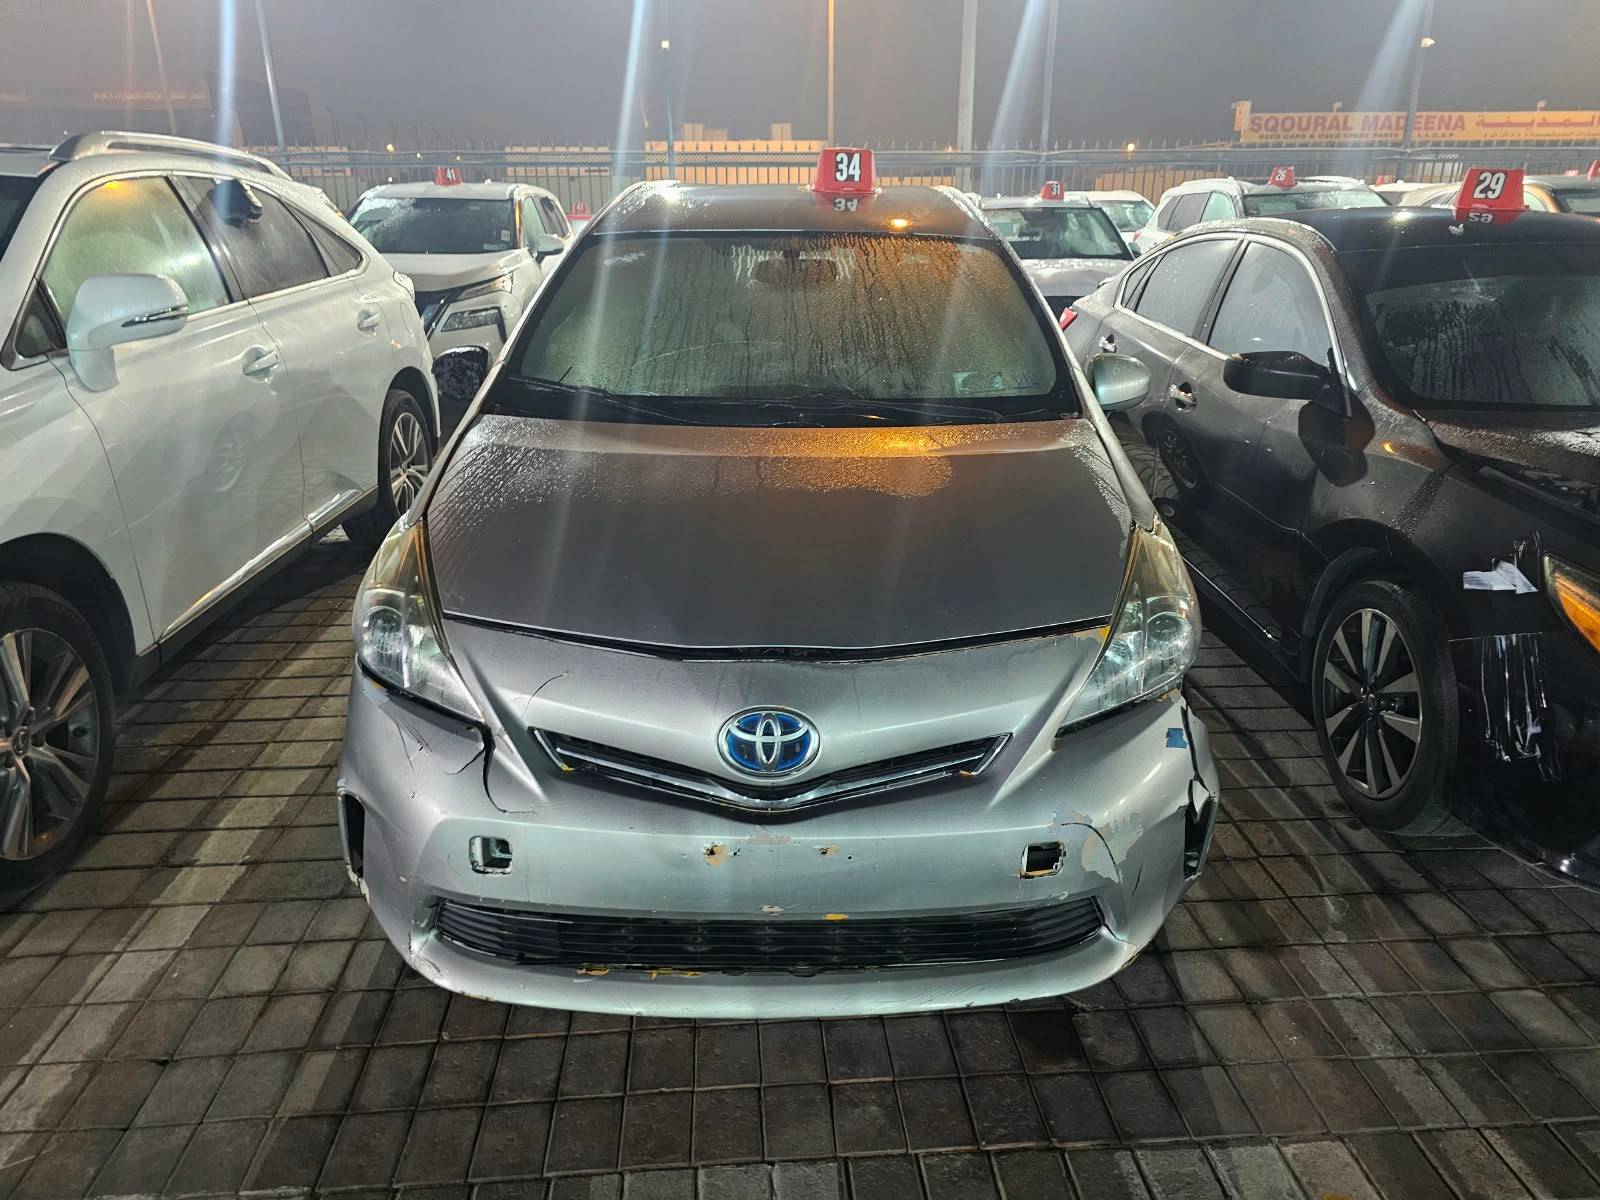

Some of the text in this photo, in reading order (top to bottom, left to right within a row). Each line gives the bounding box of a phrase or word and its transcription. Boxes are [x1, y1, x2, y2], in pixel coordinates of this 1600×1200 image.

[1250, 115, 1353, 133] SQOURAL
[835, 152, 861, 182] 34
[1473, 172, 1506, 199] 29
